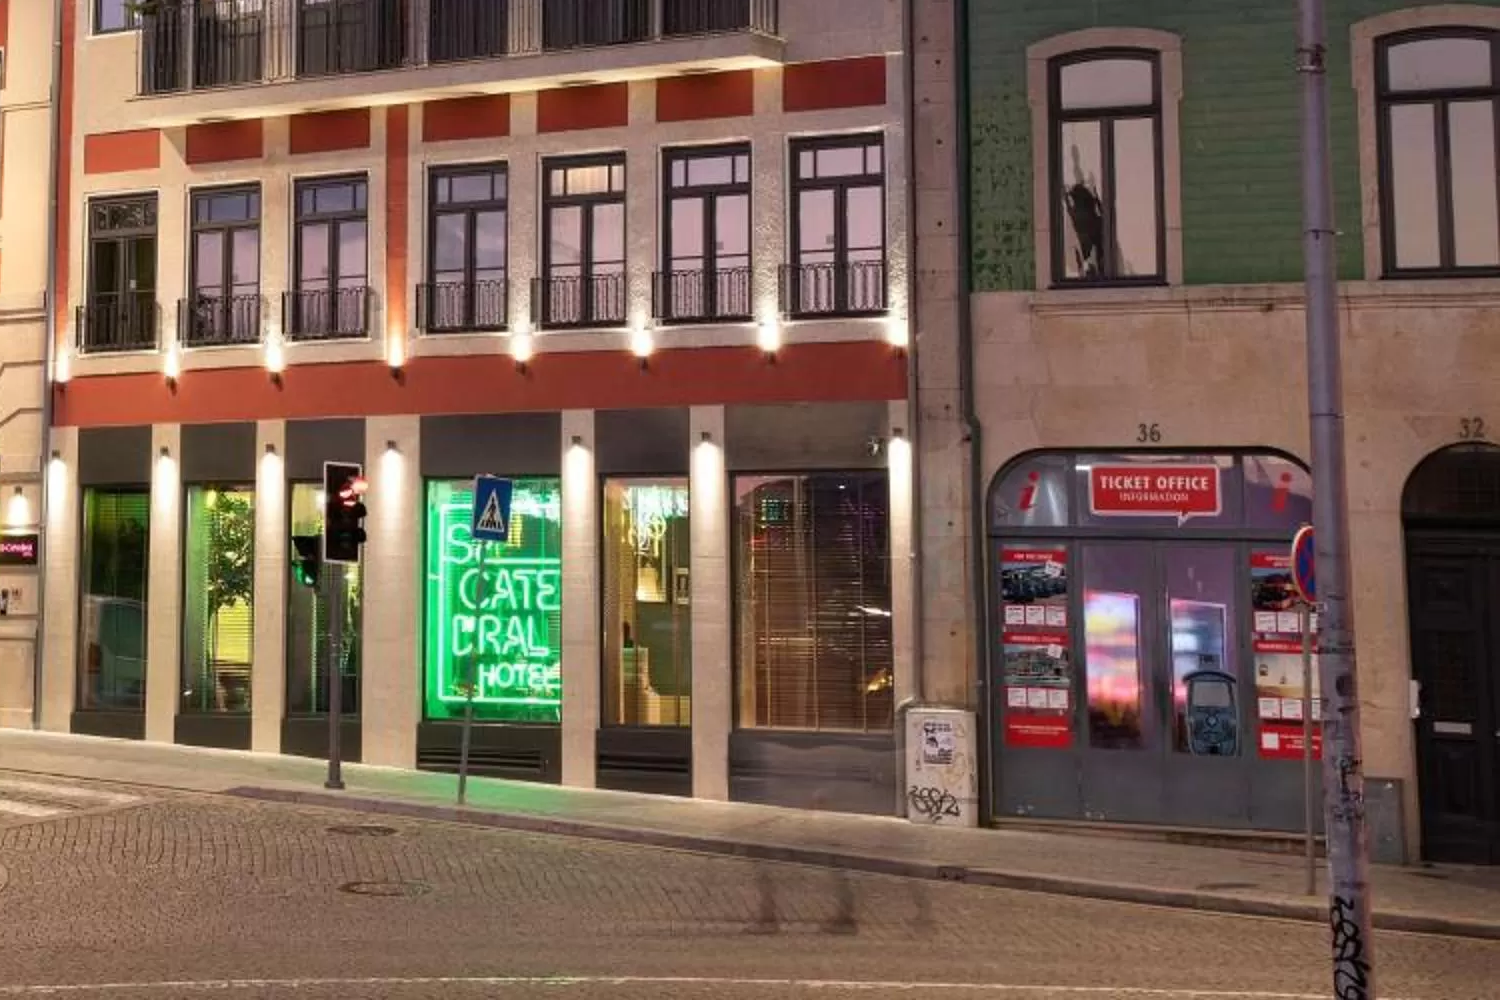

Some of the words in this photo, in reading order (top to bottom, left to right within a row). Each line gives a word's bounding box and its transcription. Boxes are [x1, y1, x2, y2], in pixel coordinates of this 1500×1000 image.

[1136, 423, 1162, 443] 36
[1459, 416, 1485, 439] 32
[1100, 475, 1150, 490] TICKET
[1156, 475, 1210, 491] OFFICE
[1119, 491, 1189, 502] INFORMATION
[459, 567, 561, 611] CATE
